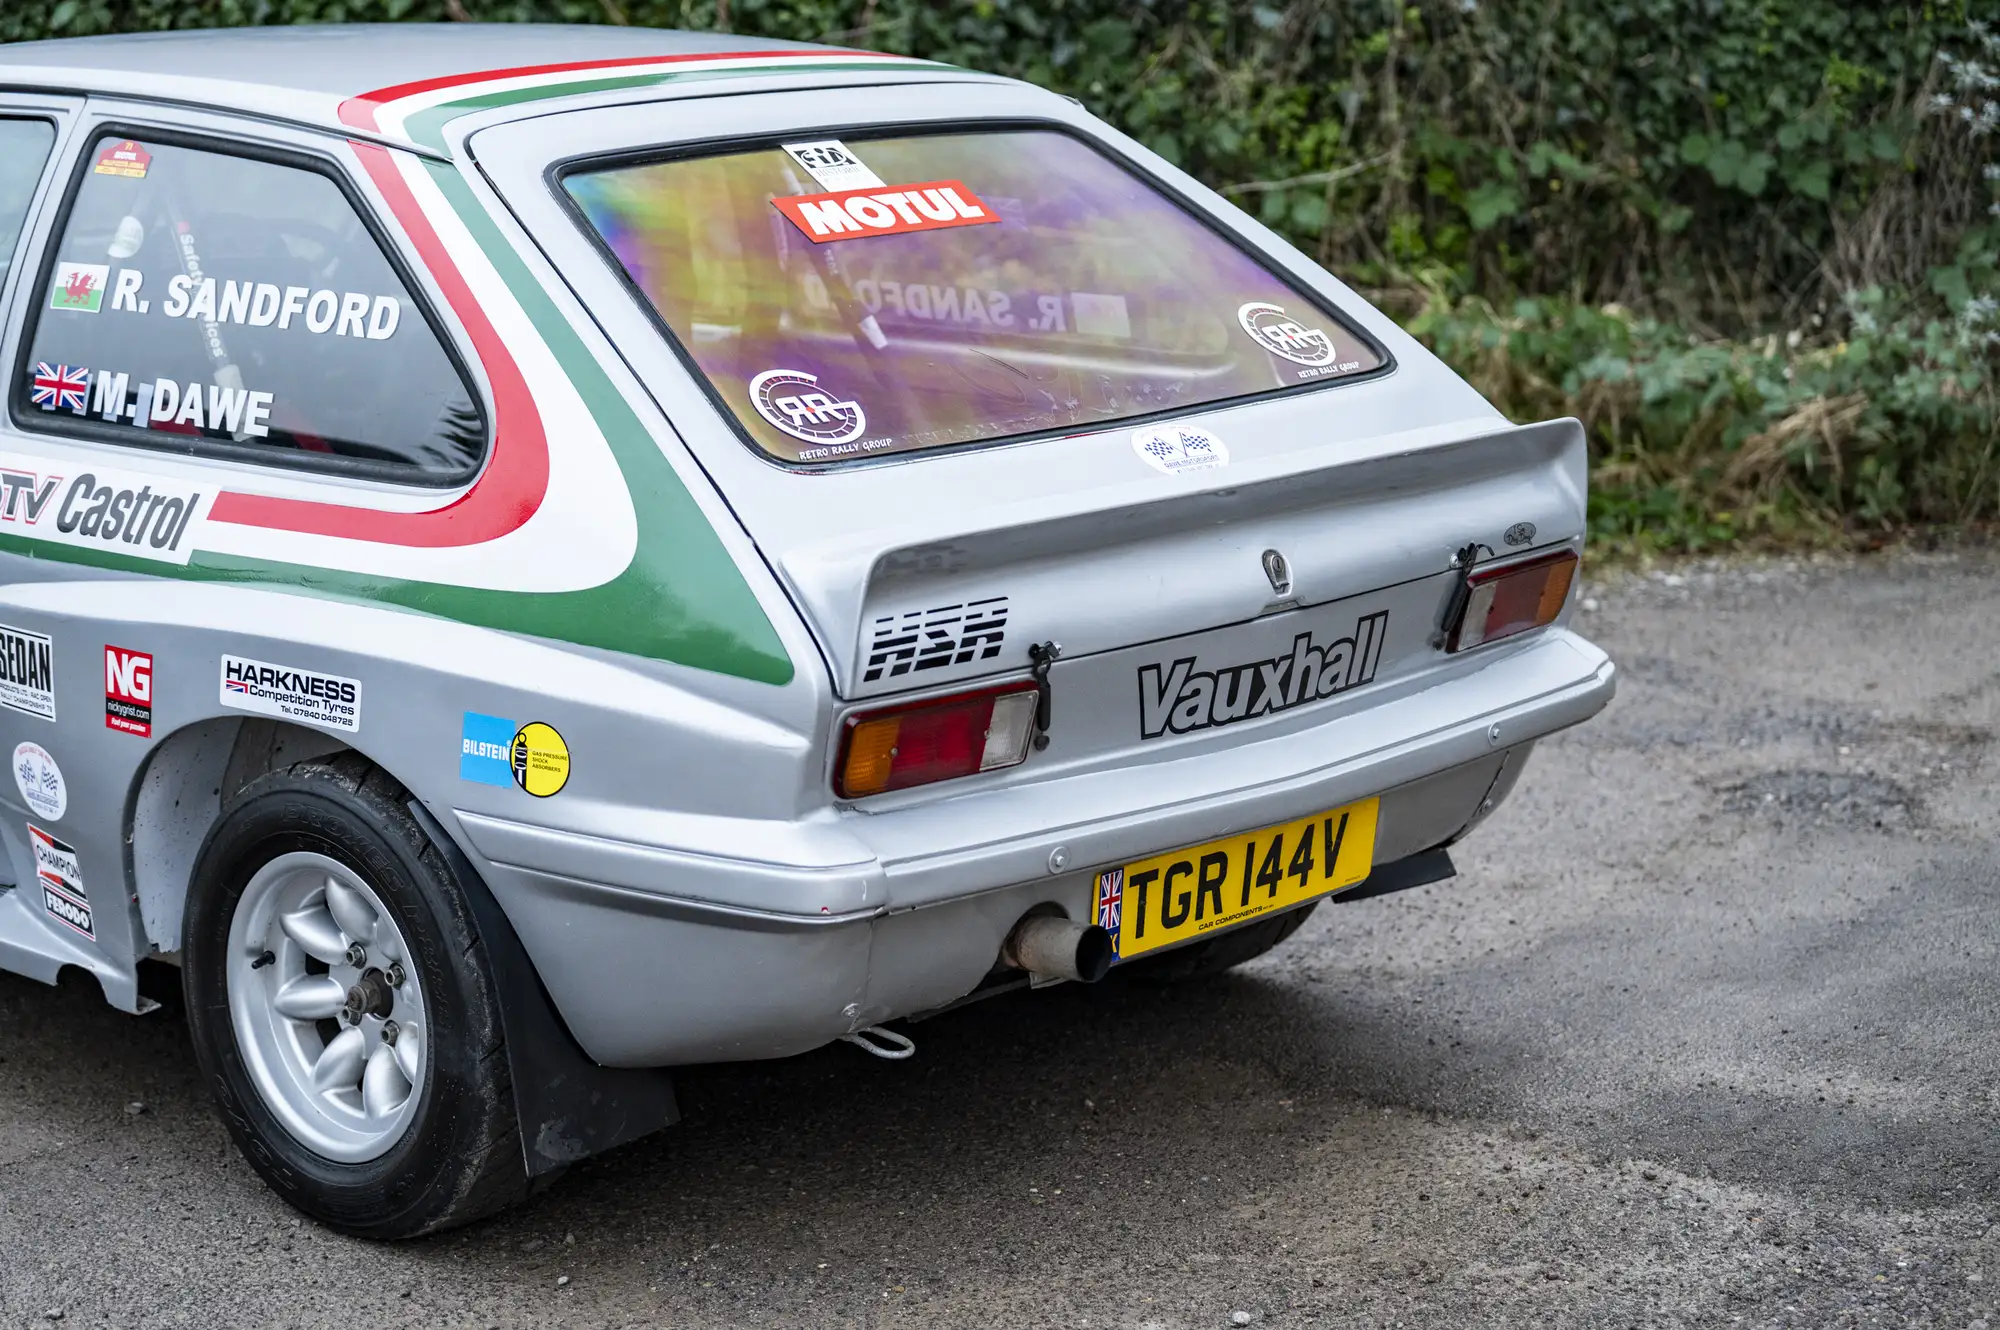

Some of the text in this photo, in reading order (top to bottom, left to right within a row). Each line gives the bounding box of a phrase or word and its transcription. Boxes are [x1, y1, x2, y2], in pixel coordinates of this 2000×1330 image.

[797, 187, 985, 235] MOTUL
[111, 268, 401, 341] R. SANDFORD
[1297, 369, 1318, 379] RETRO
[1319, 365, 1338, 375] RALLY
[93, 370, 274, 438] M. DAWE
[799, 438, 893, 461] RETRO RALLY GROUP
[0, 470, 201, 552] TV Castrol
[106, 649, 151, 702] NG
[226, 660, 356, 704] HARKNESS
[1137, 610, 1389, 740] Vauxhall
[107, 700, 150, 720] nickygrist.com
[249, 684, 355, 716] Competition Tyres
[281, 705, 293, 714] Tel.
[293, 707, 320, 720] 07840
[462, 738, 510, 762] BILSTEIN
[532, 763, 562, 773] ABSORBERS
[542, 752, 568, 761] PRESSURE
[36, 844, 81, 880] CHAMPION
[1129, 812, 1350, 939] TGR 144V
[45, 890, 90, 929] FERODO
[1198, 921, 1214, 931] CAR
[1214, 905, 1264, 926] COMPONENTS
